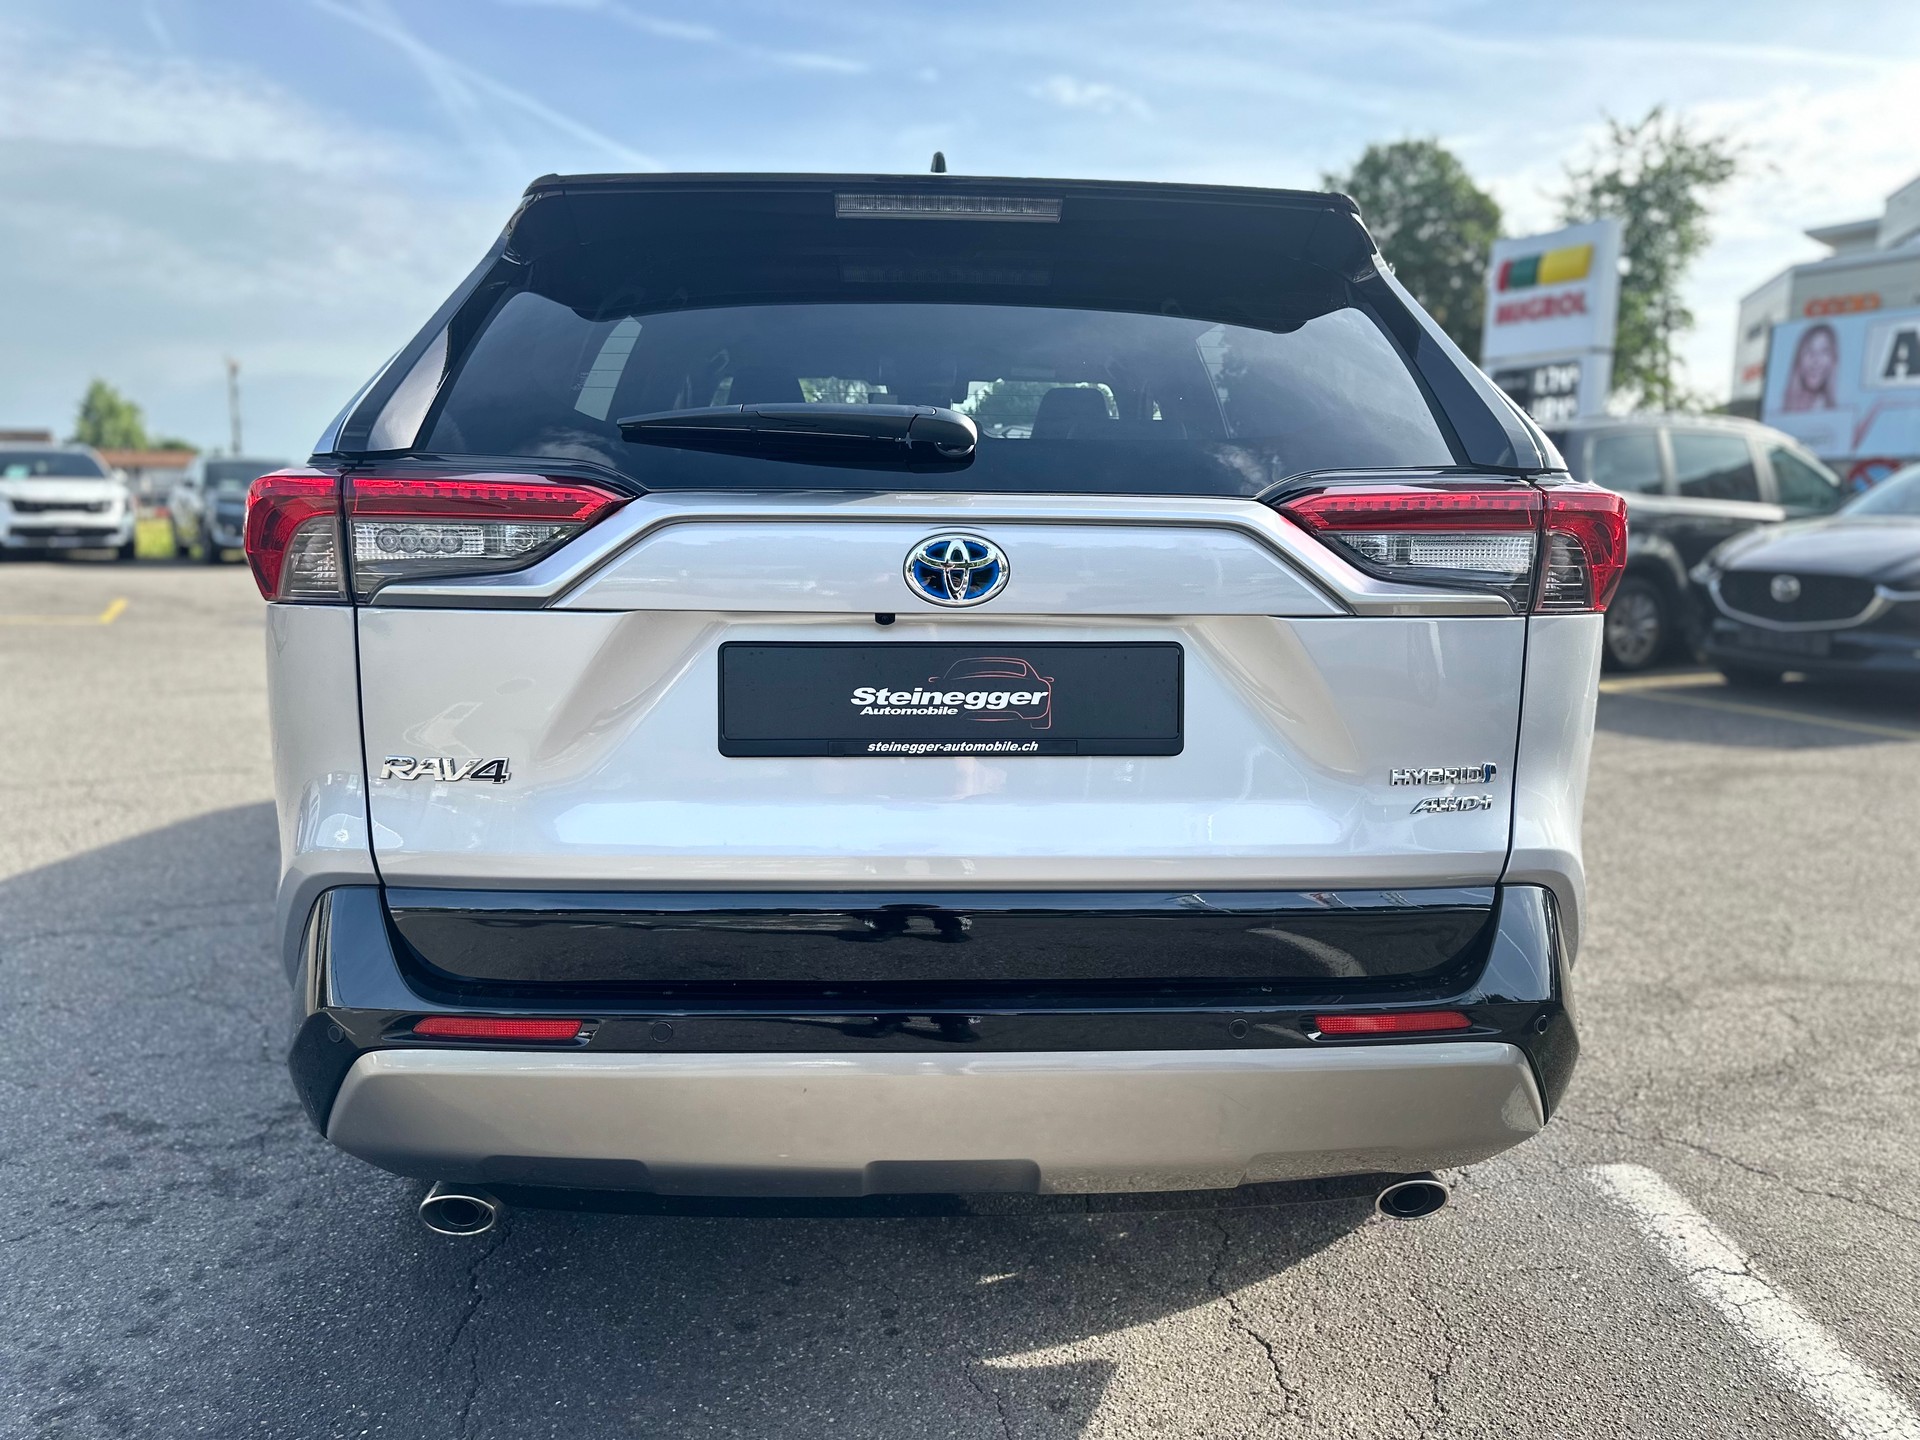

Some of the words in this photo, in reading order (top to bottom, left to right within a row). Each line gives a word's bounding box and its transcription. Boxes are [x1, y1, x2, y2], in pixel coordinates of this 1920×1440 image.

[1494, 290, 1588, 326] MIGROL
[850, 686, 1049, 710] Steinegger
[859, 706, 959, 715] Automobile
[867, 741, 1039, 754] steinegger-automobile.ch
[379, 756, 512, 784] RAV4
[1389, 766, 1484, 786] HYBRID
